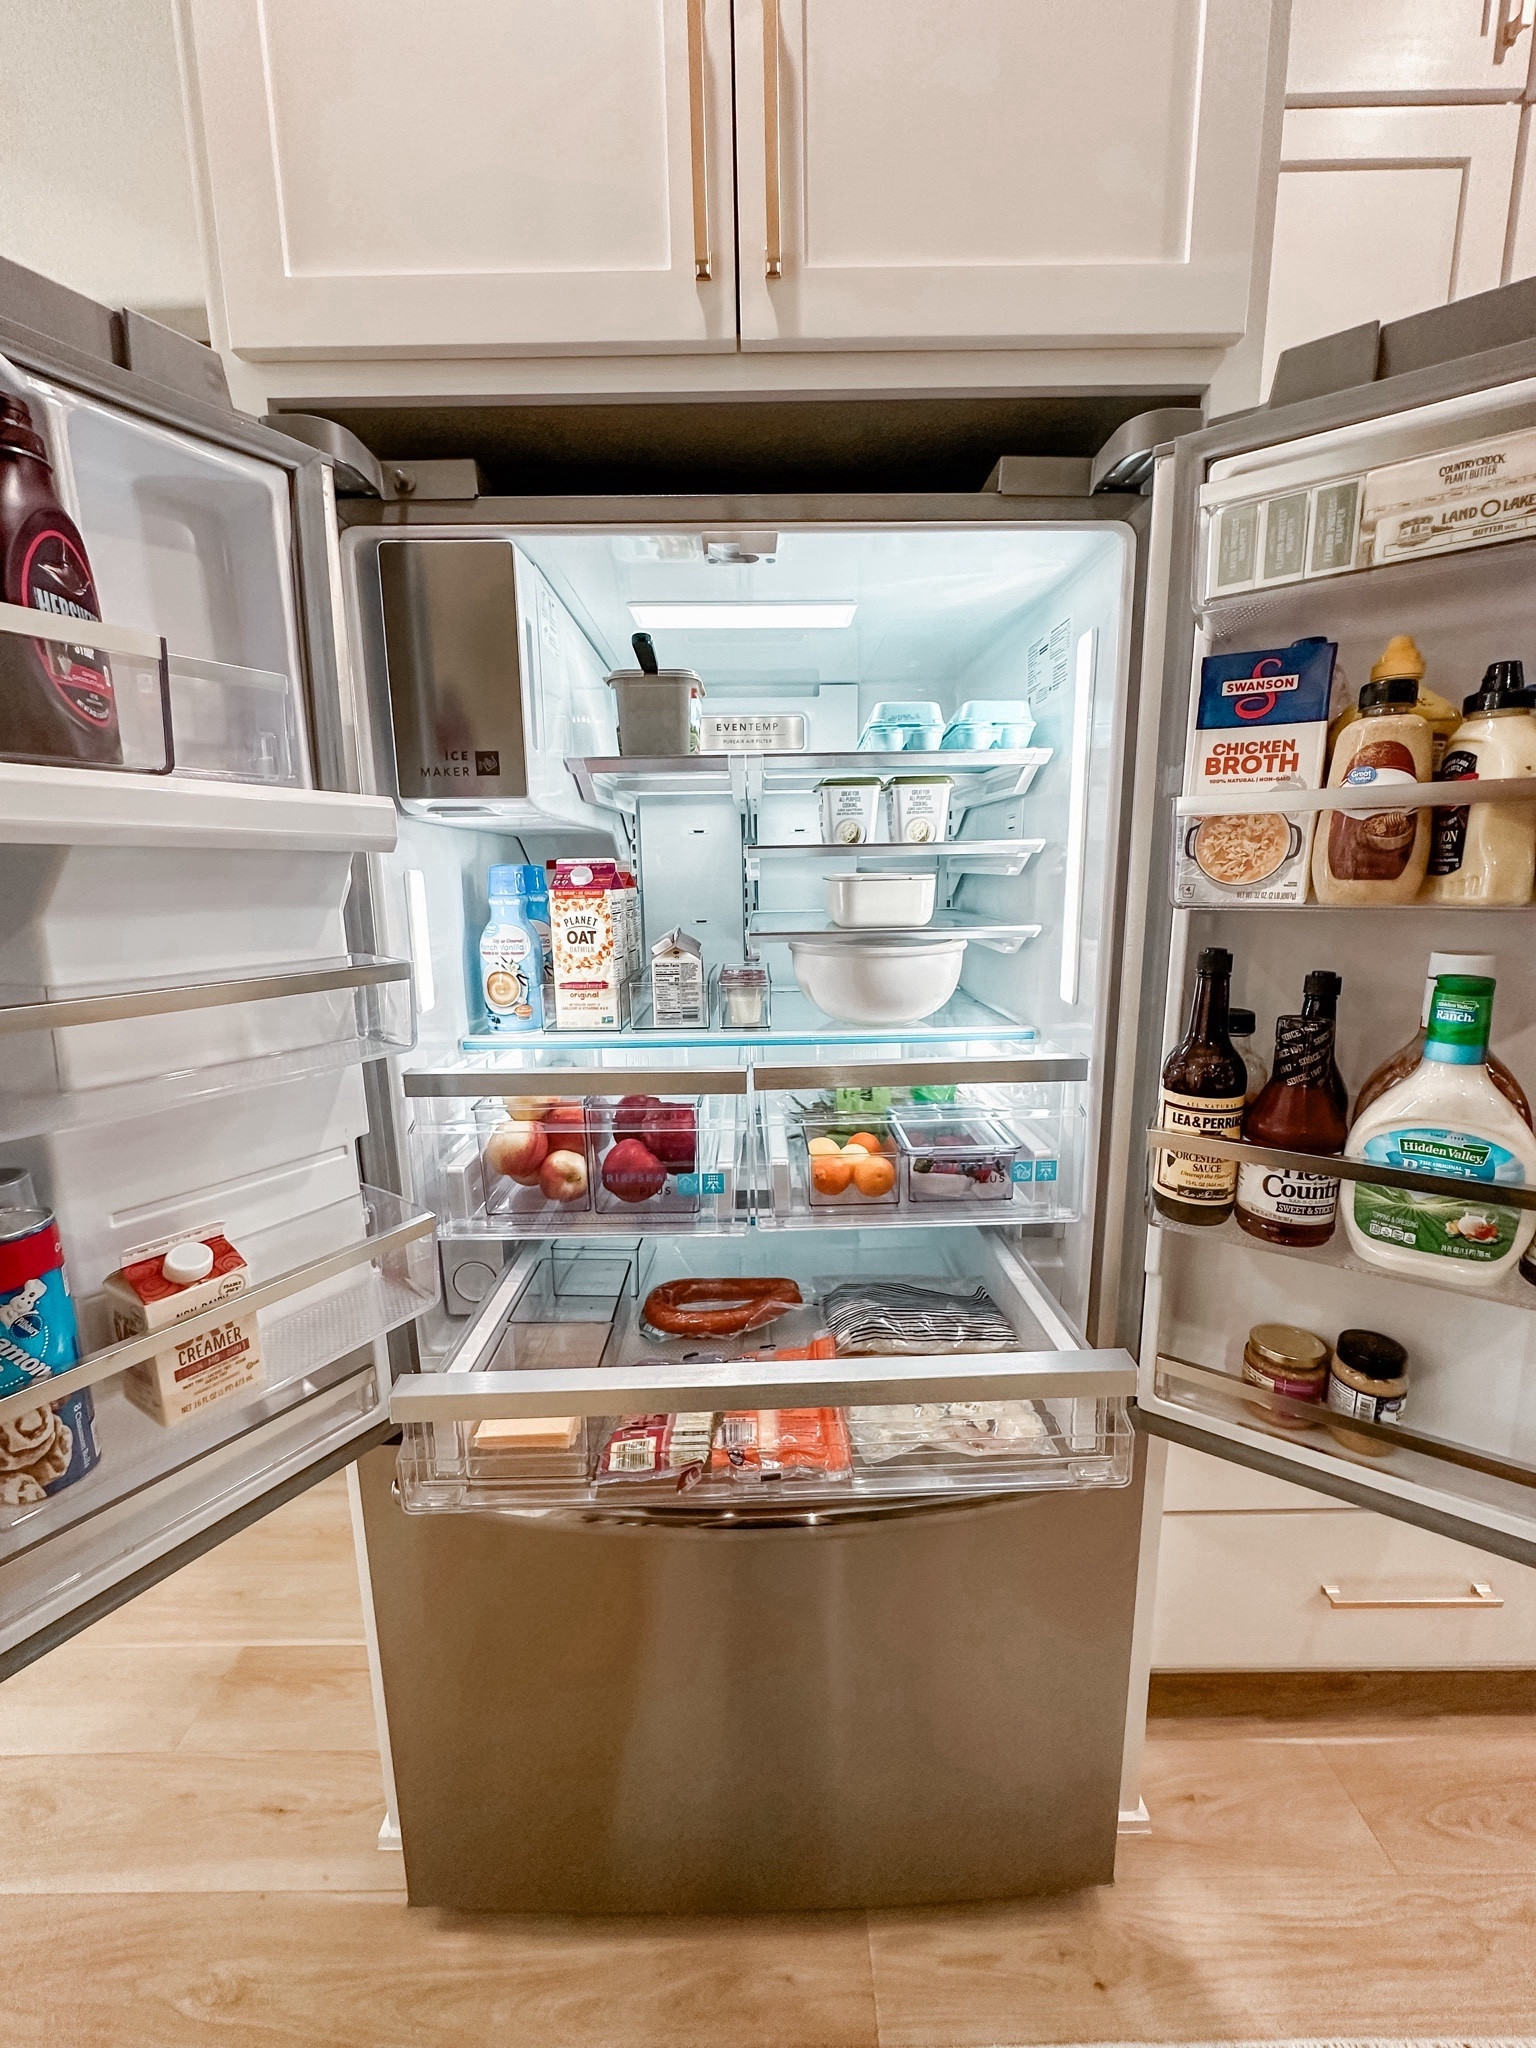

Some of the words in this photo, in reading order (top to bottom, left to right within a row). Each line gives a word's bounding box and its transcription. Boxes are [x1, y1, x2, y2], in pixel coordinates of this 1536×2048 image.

[1444, 471, 1468, 485] PLANT
[1469, 464, 1498, 480] BUTTER
[1441, 506, 1479, 525] LAND
[1472, 524, 1504, 537] BUTTER
[1226, 677, 1295, 693] SWANSON
[716, 722, 779, 731] EVENTEMP
[1212, 738, 1296, 756] CHICKEN
[445, 750, 468, 761] ICE
[420, 766, 470, 777] MAKER
[1205, 753, 1300, 776] BROTH
[563, 915, 598, 927] PLANET
[566, 930, 597, 945] OAT
[500, 943, 524, 952] Vanilla
[569, 991, 600, 1001] original
[1286, 1073, 1309, 1086] SINCE
[1172, 1111, 1191, 1127] LEA
[1191, 1116, 1201, 1128] &
[1403, 1141, 1447, 1156] Hidden
[1192, 1163, 1221, 1173] SAUCE
[1432, 1161, 1464, 1172] ORIGINAL
[640, 1186, 671, 1195] PLUS
[1262, 1174, 1338, 1199] Countr
[1278, 1204, 1306, 1214] SWEET
[1307, 1205, 1314, 1214] &
[1372, 1210, 1391, 1222] TOPPING
[1395, 1217, 1419, 1229] DRESSING
[14, 1316, 40, 1338] Pillsbury
[178, 1326, 242, 1366] CREAMER
[74, 1402, 81, 1412] 8
[181, 1404, 192, 1414] NET
[202, 1396, 209, 1404] FL
[209, 1392, 217, 1400] OZ
[75, 1411, 87, 1450] Cinnamon
[81, 1447, 90, 1469] Rolls
